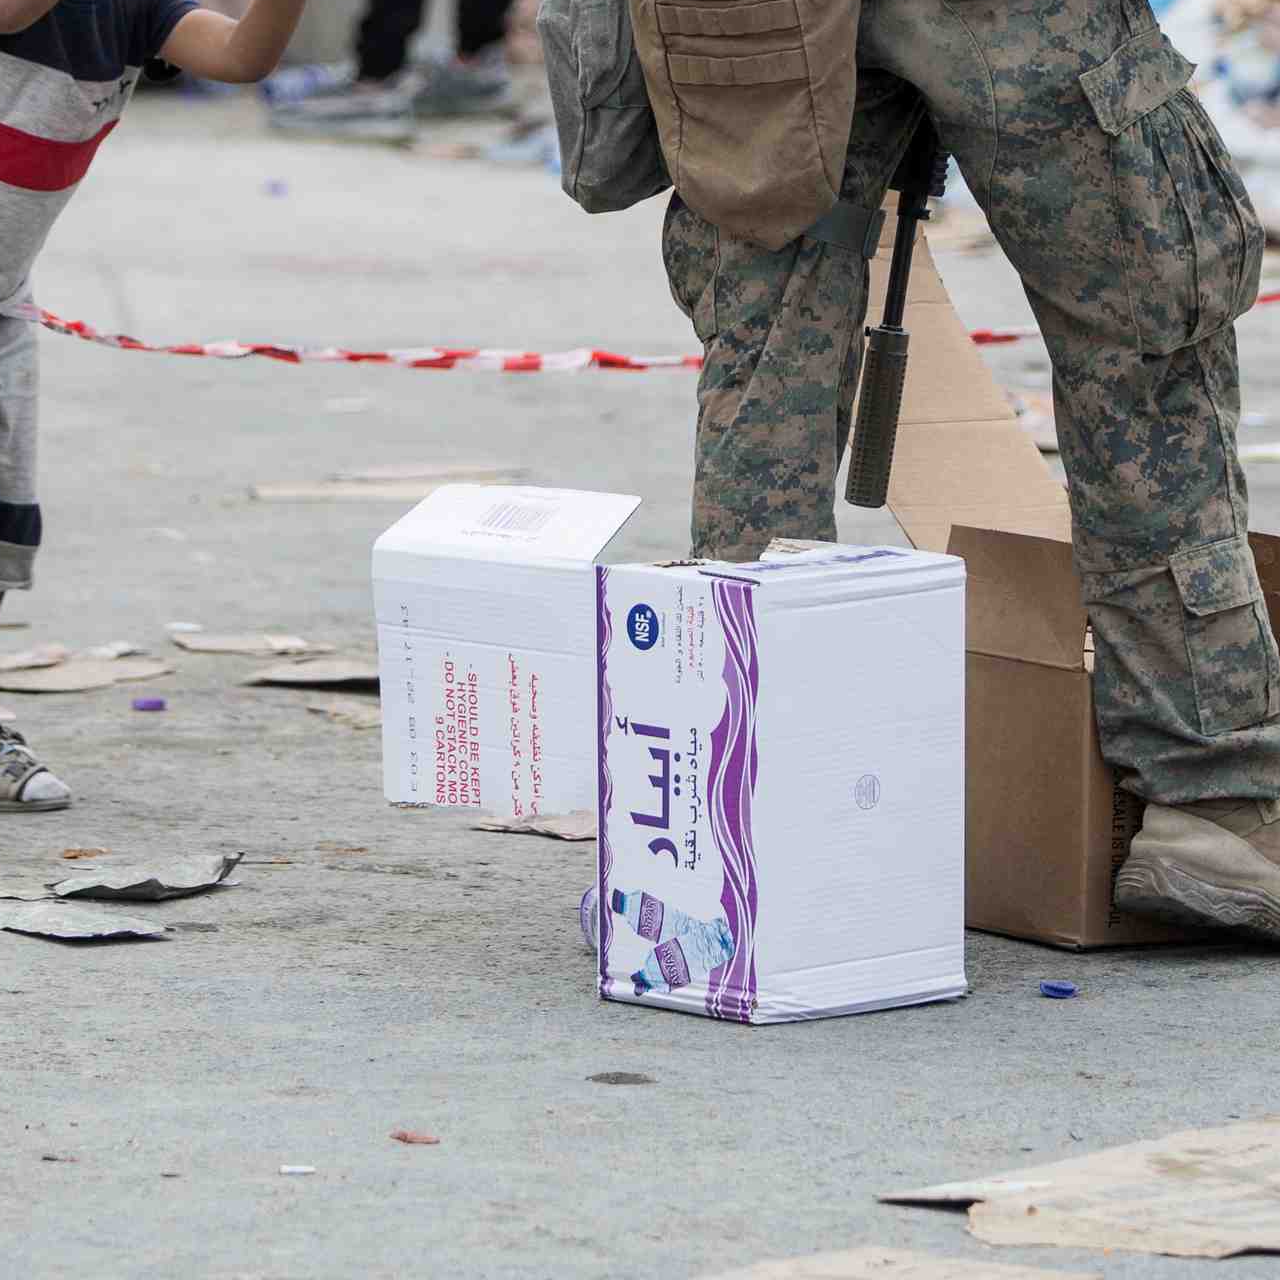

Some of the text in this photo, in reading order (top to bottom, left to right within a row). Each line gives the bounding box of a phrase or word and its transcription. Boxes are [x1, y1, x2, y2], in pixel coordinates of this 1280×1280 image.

[635, 612, 650, 642] NSF
[435, 729, 446, 804] CARTONS
[444, 661, 458, 804] DO NOT STACK MO
[456, 682, 469, 804] HYGIENIC COND
[467, 672, 481, 806] SHOULD BE KEPT
[616, 716, 681, 868] أبيار
[684, 728, 703, 870] مياه شرب نقية
